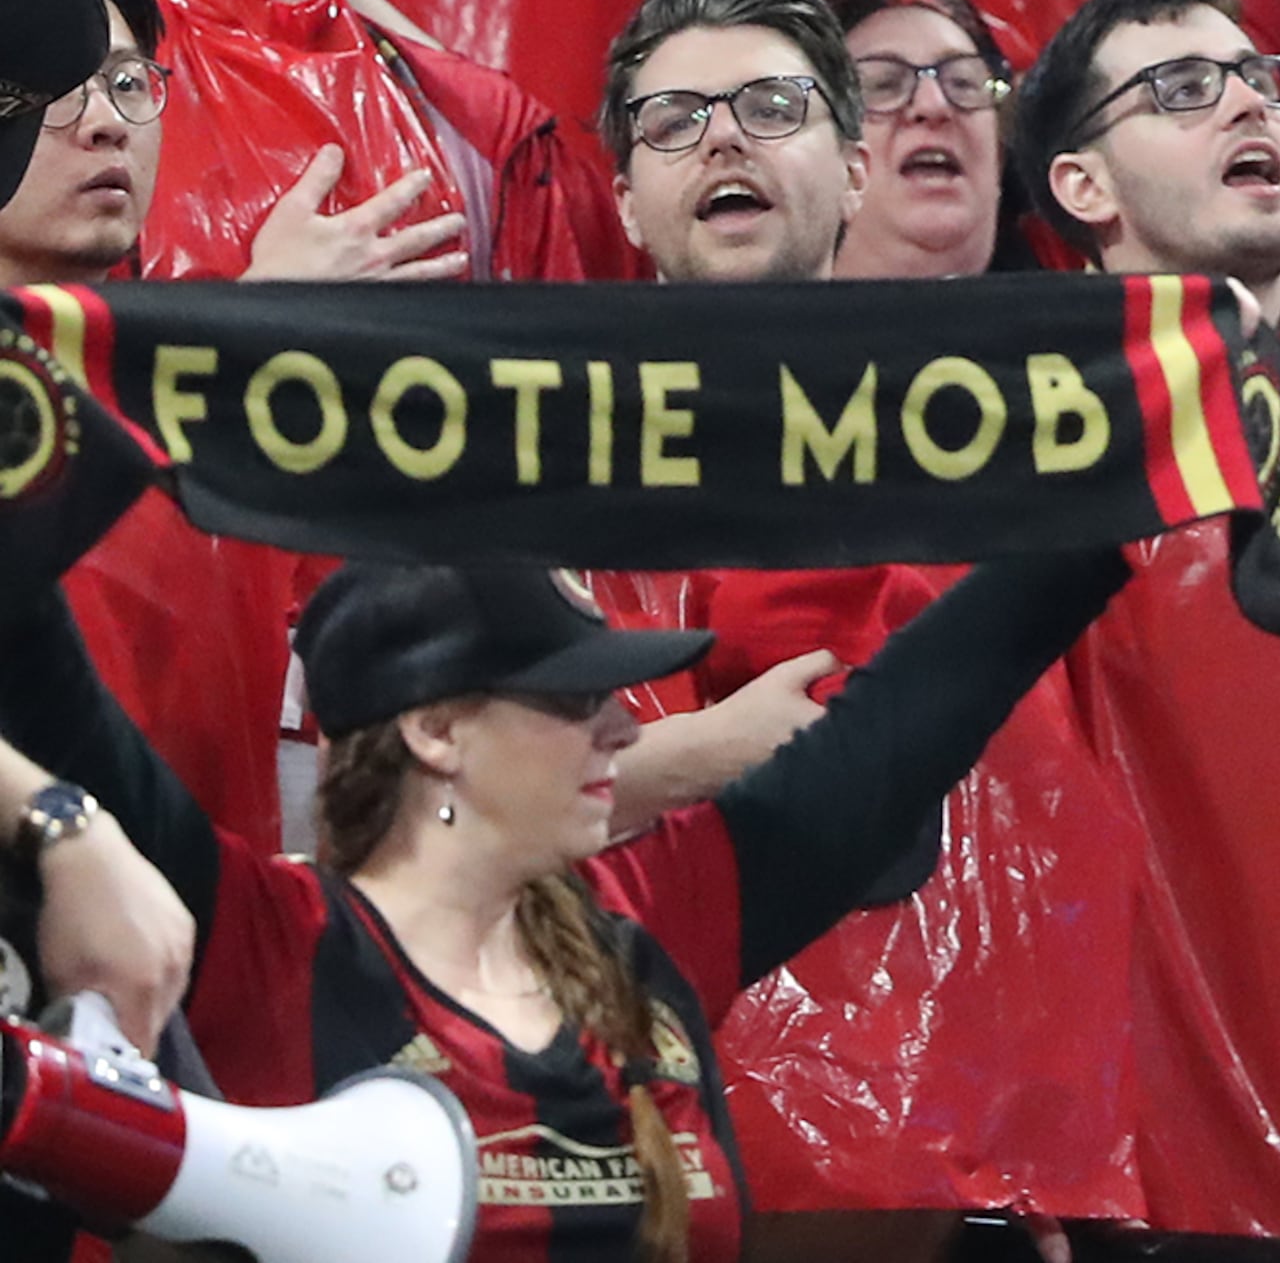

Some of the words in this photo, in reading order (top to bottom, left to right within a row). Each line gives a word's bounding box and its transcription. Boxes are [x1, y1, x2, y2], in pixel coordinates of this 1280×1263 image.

[152, 345, 701, 486] FOOTIE
[780, 351, 1111, 486] MOB
[478, 1151, 602, 1179] MERICAN
